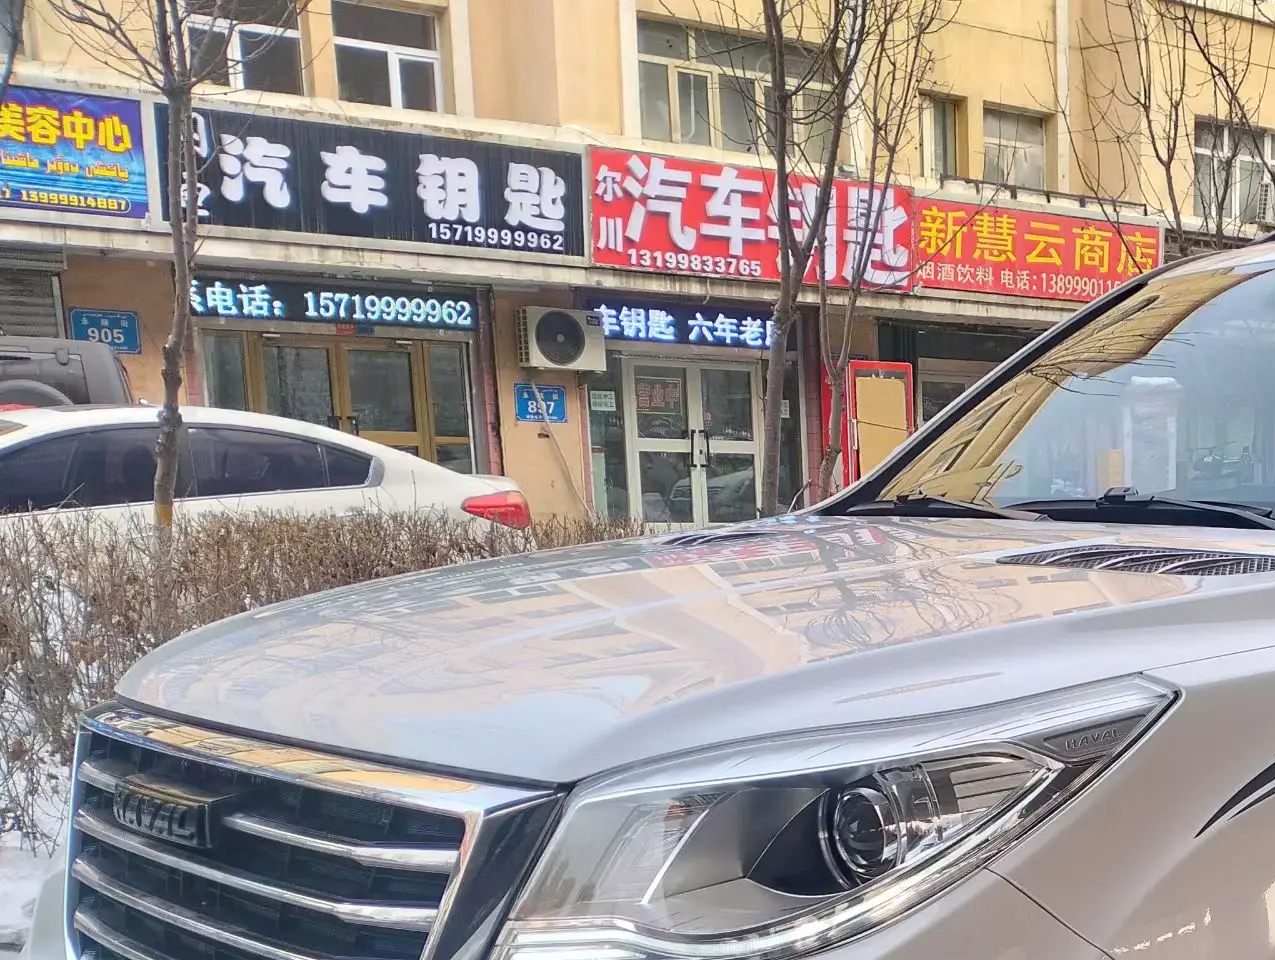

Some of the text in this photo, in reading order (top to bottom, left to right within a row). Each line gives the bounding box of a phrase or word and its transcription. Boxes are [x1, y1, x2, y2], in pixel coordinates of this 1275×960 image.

[0, 102, 132, 152] 美容中心
[219, 133, 566, 231] 汽车钥匙
[428, 222, 565, 250] 15719999962
[919, 205, 1157, 277] 新慧云商店
[627, 248, 762, 276] 13199833765
[916, 260, 994, 287] 烟酒饮料
[303, 291, 472, 325] 15719999962
[593, 303, 676, 341] 车钥匙
[87, 327, 124, 343] 905
